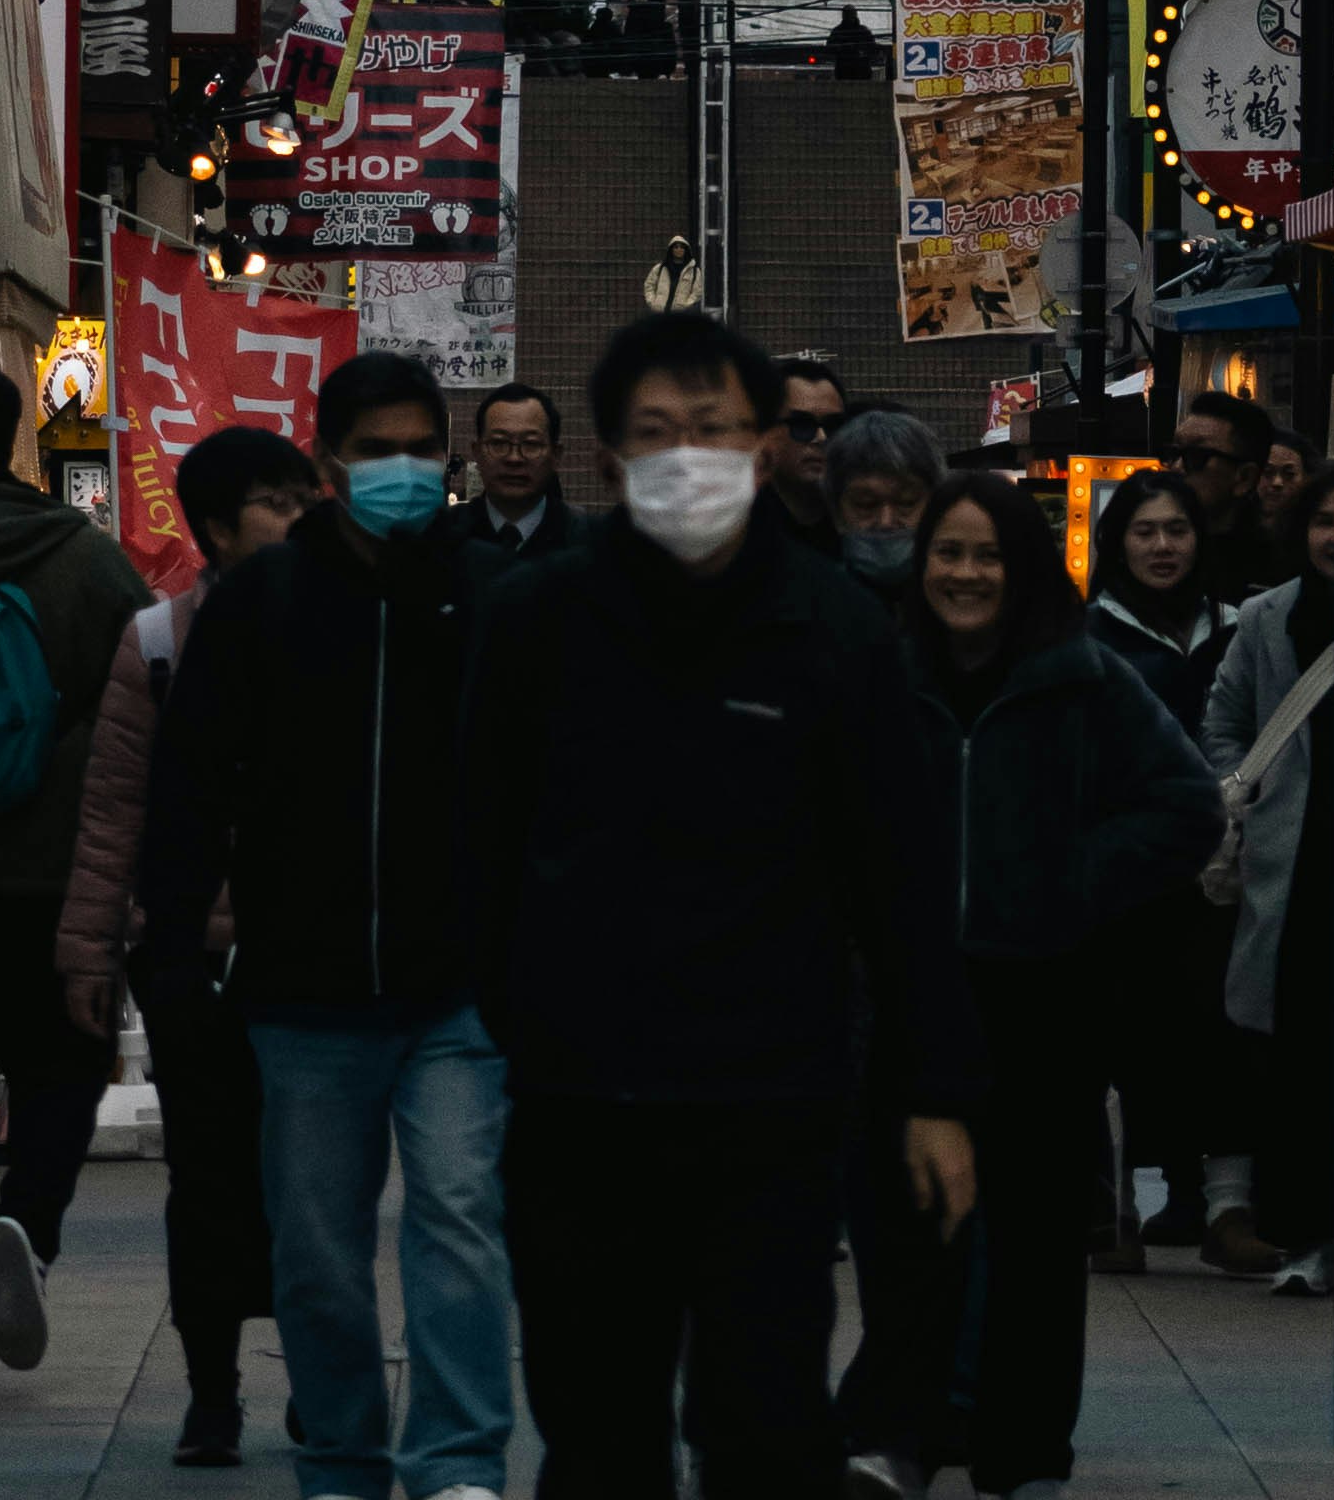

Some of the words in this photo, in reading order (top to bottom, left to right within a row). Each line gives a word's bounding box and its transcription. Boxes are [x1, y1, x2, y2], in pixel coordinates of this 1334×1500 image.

[303, 154, 419, 183] SHOP
[299, 190, 352, 208] Osaka
[356, 189, 430, 207] souvenir
